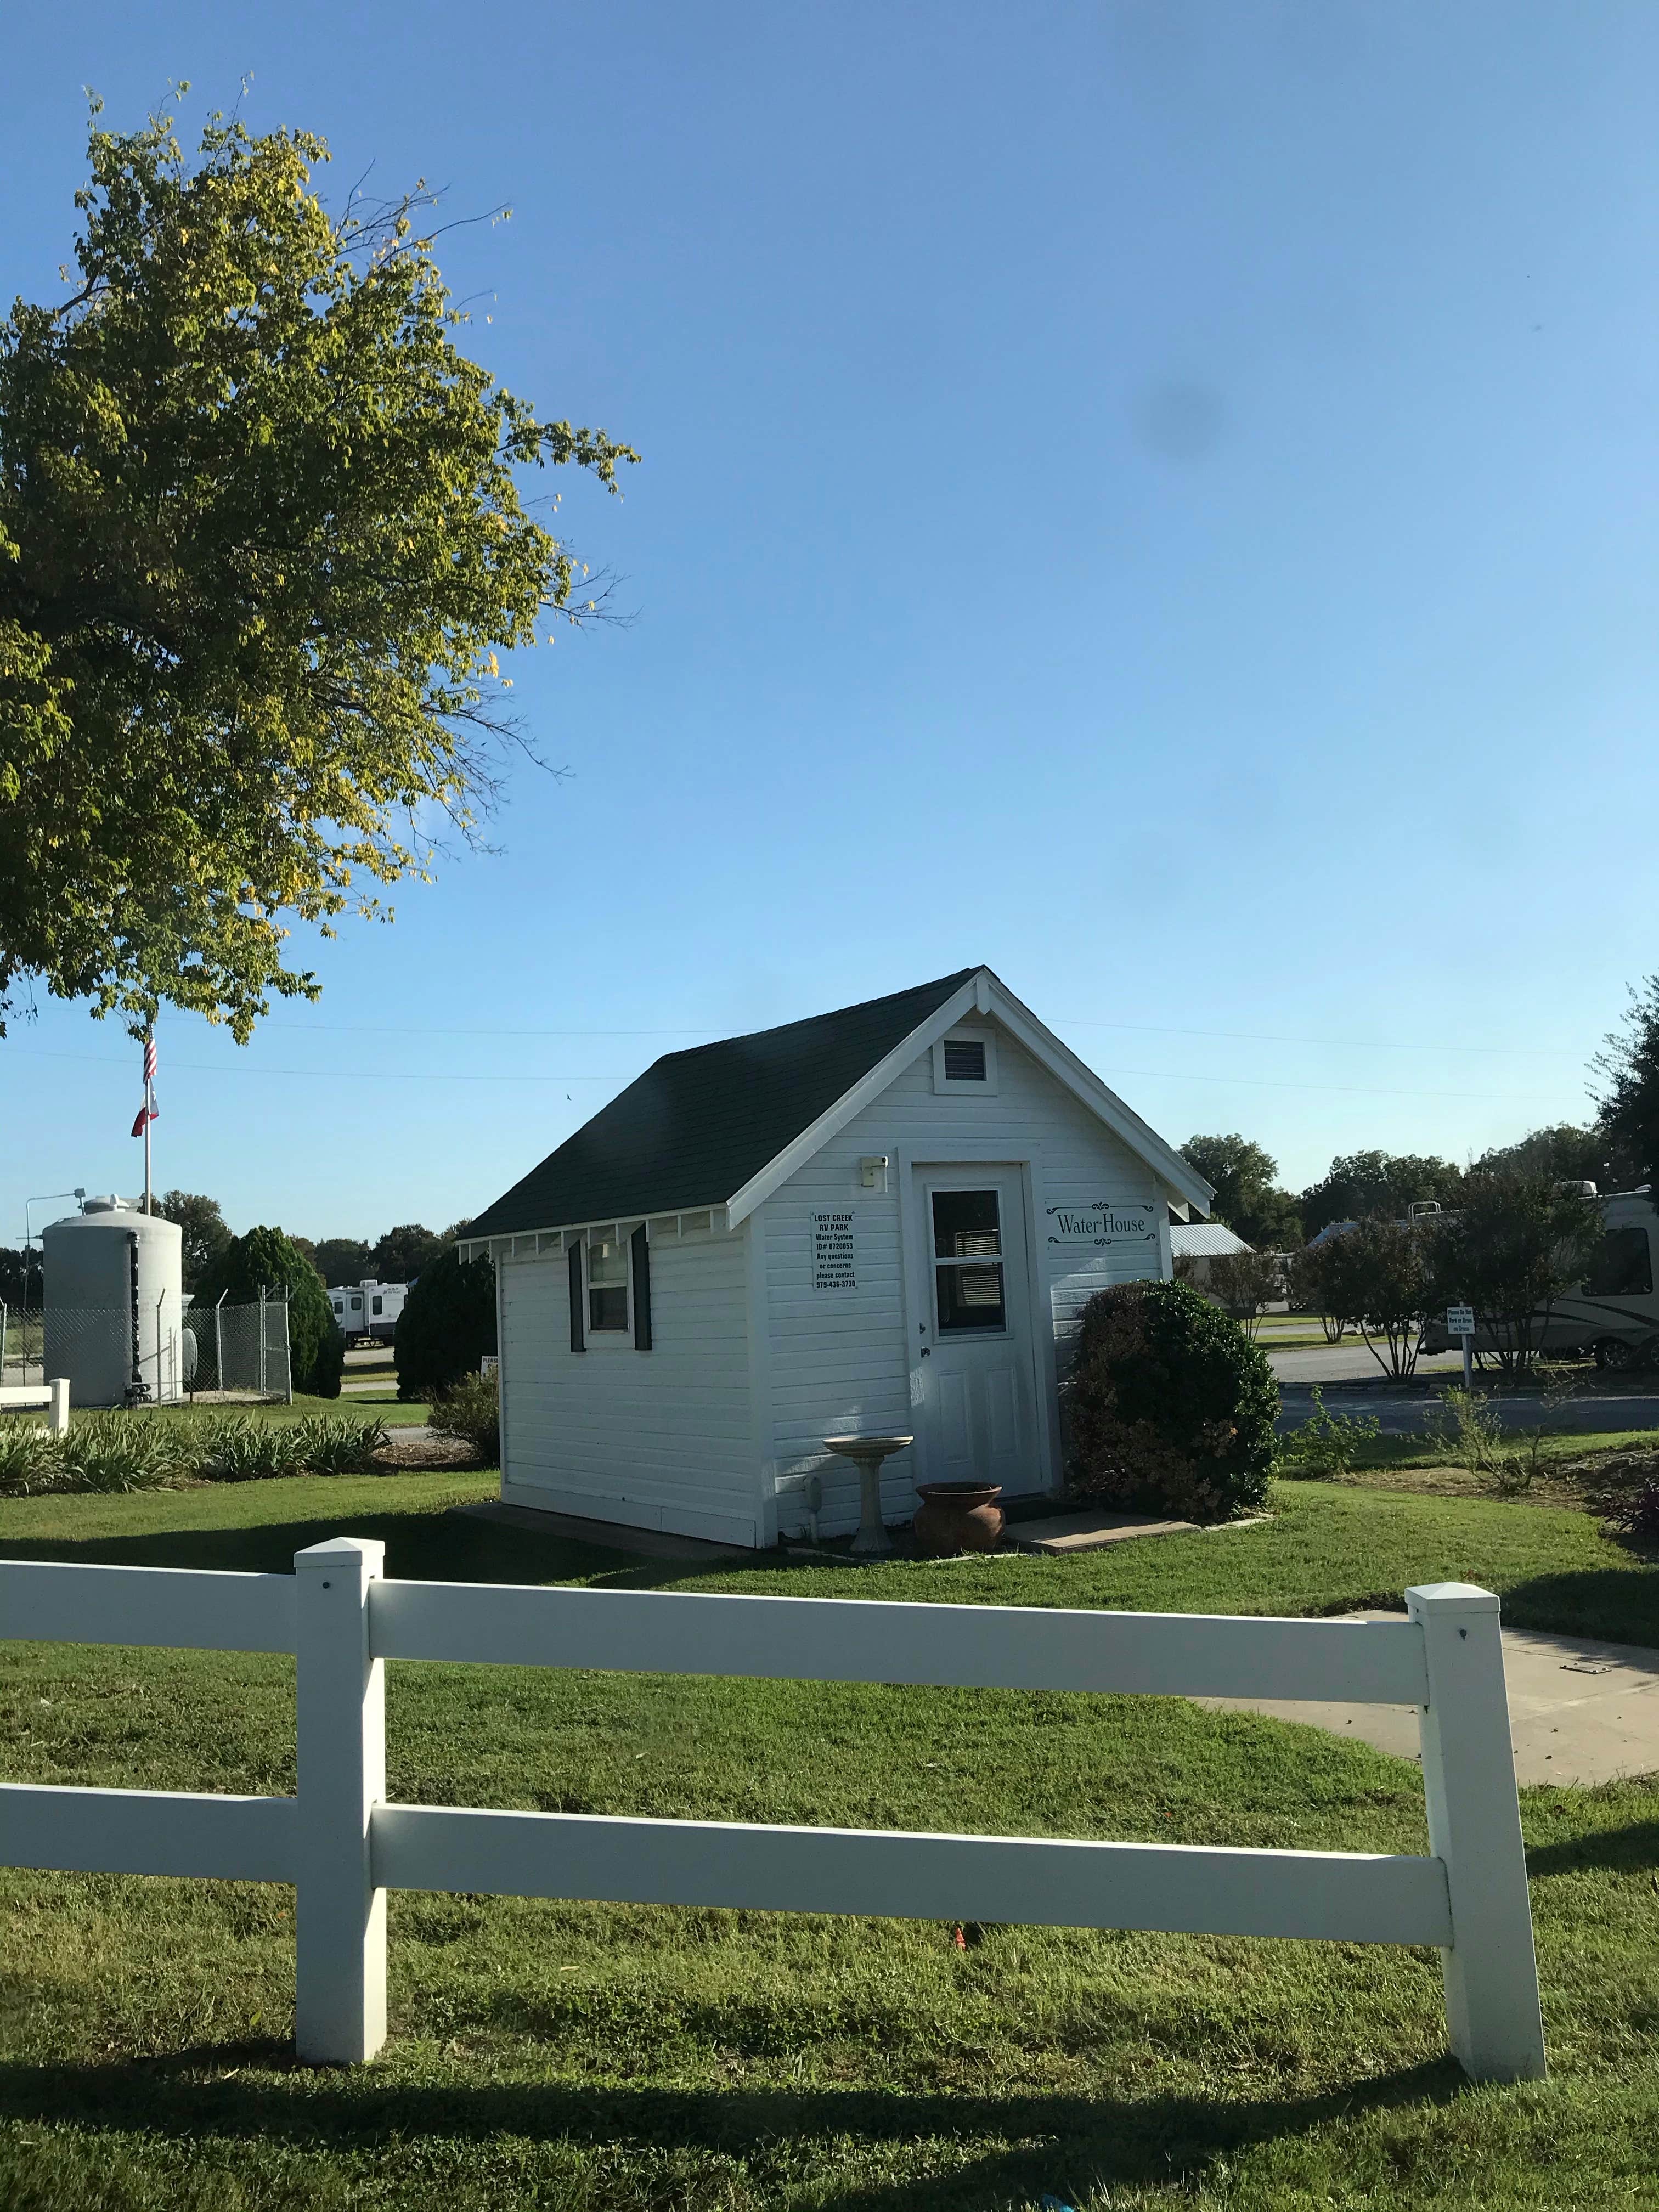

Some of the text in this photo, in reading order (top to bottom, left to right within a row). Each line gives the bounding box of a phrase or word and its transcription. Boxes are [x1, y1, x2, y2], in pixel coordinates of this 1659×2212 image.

[834, 1233, 853, 1242] System
[828, 1252, 854, 1261] questions
[816, 1272, 833, 1280] please
[816, 1280, 856, 1289] 979-436-3730
